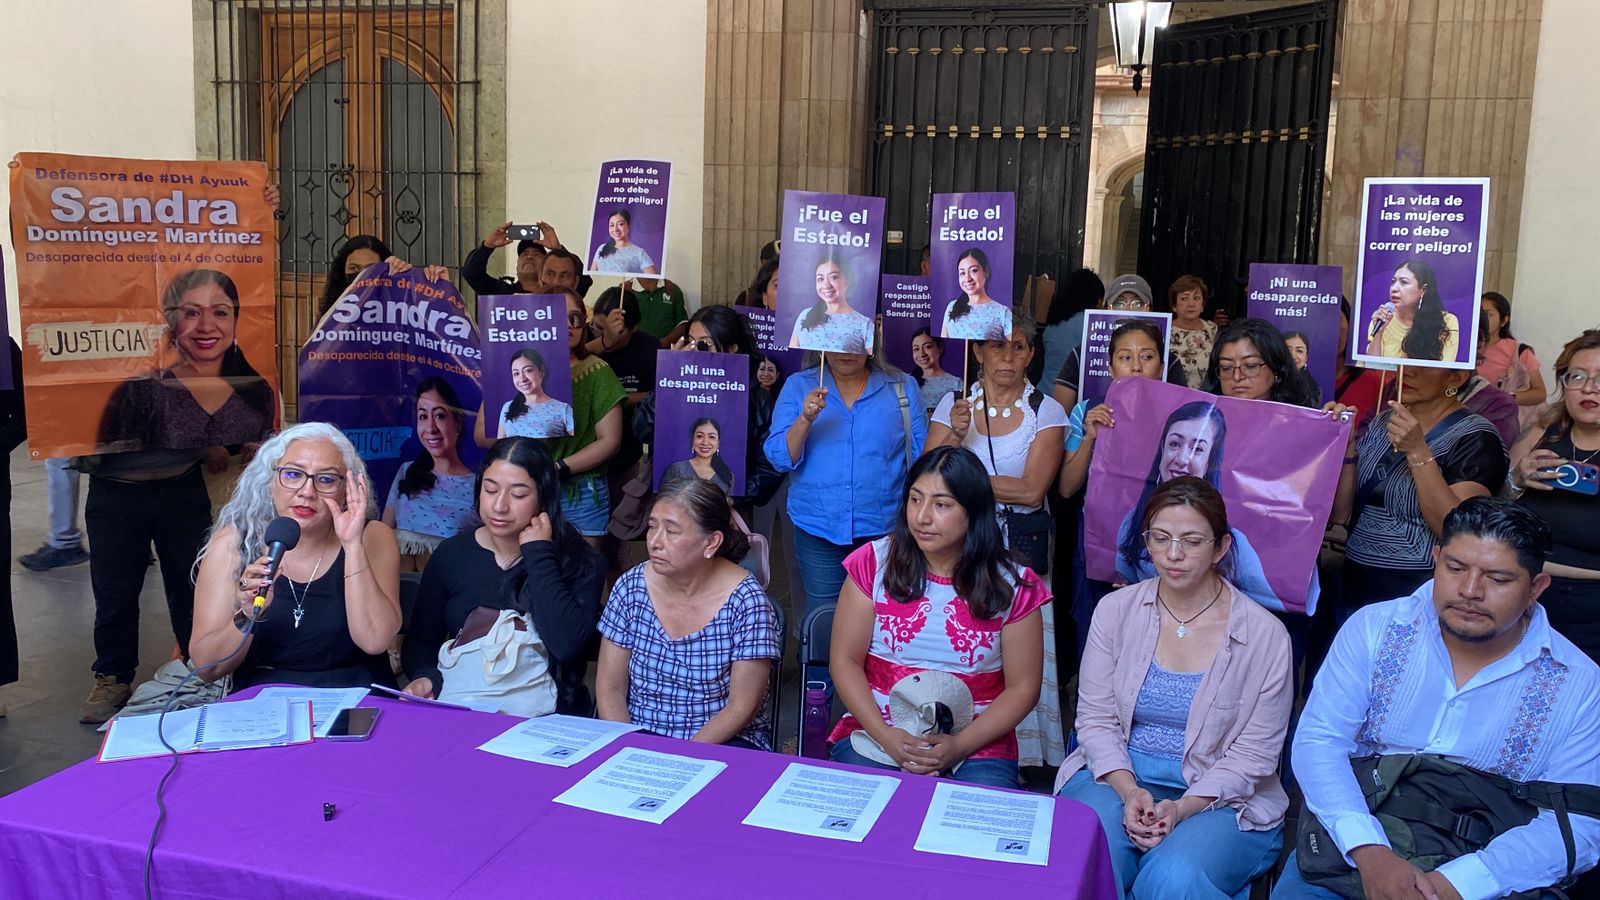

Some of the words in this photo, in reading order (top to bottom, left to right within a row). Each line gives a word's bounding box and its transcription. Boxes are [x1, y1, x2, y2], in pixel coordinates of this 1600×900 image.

[35, 167, 127, 182] Defensora
[133, 171, 154, 183] de
[159, 173, 194, 185] #DH
[199, 175, 249, 188] Ayuuk
[610, 166, 623, 176] ¡La
[625, 166, 644, 175] vida
[646, 167, 658, 175] de
[607, 176, 620, 184] las
[622, 176, 659, 185] mujeres
[627, 186, 649, 194] debe
[50, 186, 238, 225] Sandra
[628, 196, 664, 206] peligro!
[1384, 194, 1405, 208] ¡La
[1410, 194, 1440, 206] vida
[1444, 195, 1463, 206] de
[799, 204, 843, 223] ¡Fue
[849, 209, 868, 225] el
[943, 205, 979, 223] ¡Fue
[984, 204, 1001, 220] el
[1380, 209, 1401, 221] las
[1405, 210, 1464, 224] mujeres
[26, 225, 158, 246] Domínguez
[165, 227, 261, 244] Martínez
[793, 226, 871, 248] Estado!
[939, 226, 1004, 242] Estado!
[1391, 226, 1409, 236] no
[1413, 225, 1449, 237] debe
[1369, 241, 1412, 251] correr
[1415, 241, 1473, 255] peligro!
[26, 252, 123, 265] Desaparecida
[127, 252, 166, 263] desde
[170, 253, 180, 263] el
[184, 254, 192, 263] 4
[195, 253, 211, 263] de
[214, 254, 263, 264] Octubre
[355, 278, 392, 289] nsora
[414, 282, 446, 299] #DH
[896, 283, 928, 292] Castigo
[1270, 277, 1288, 289] ¡Ni
[1292, 280, 1317, 289] una
[1250, 290, 1338, 305] desaparecida
[332, 294, 471, 339] Sandra
[490, 306, 529, 325] ¡Fue
[534, 305, 552, 320] el
[748, 312, 765, 321] Una
[886, 310, 915, 318] Sandra
[1275, 306, 1307, 317] más!
[1091, 320, 1106, 331] ¡Ni
[488, 326, 557, 342] Estado!
[312, 326, 411, 346] Domínguez
[414, 332, 482, 360] Martínez
[308, 350, 385, 362] Desaparecida
[427, 356, 433, 367] 4
[1090, 358, 1104, 367] ¡Ni
[680, 364, 698, 377] ¡Ni
[702, 367, 725, 377] una
[659, 377, 746, 392] desaparecida
[686, 393, 718, 404] más!
